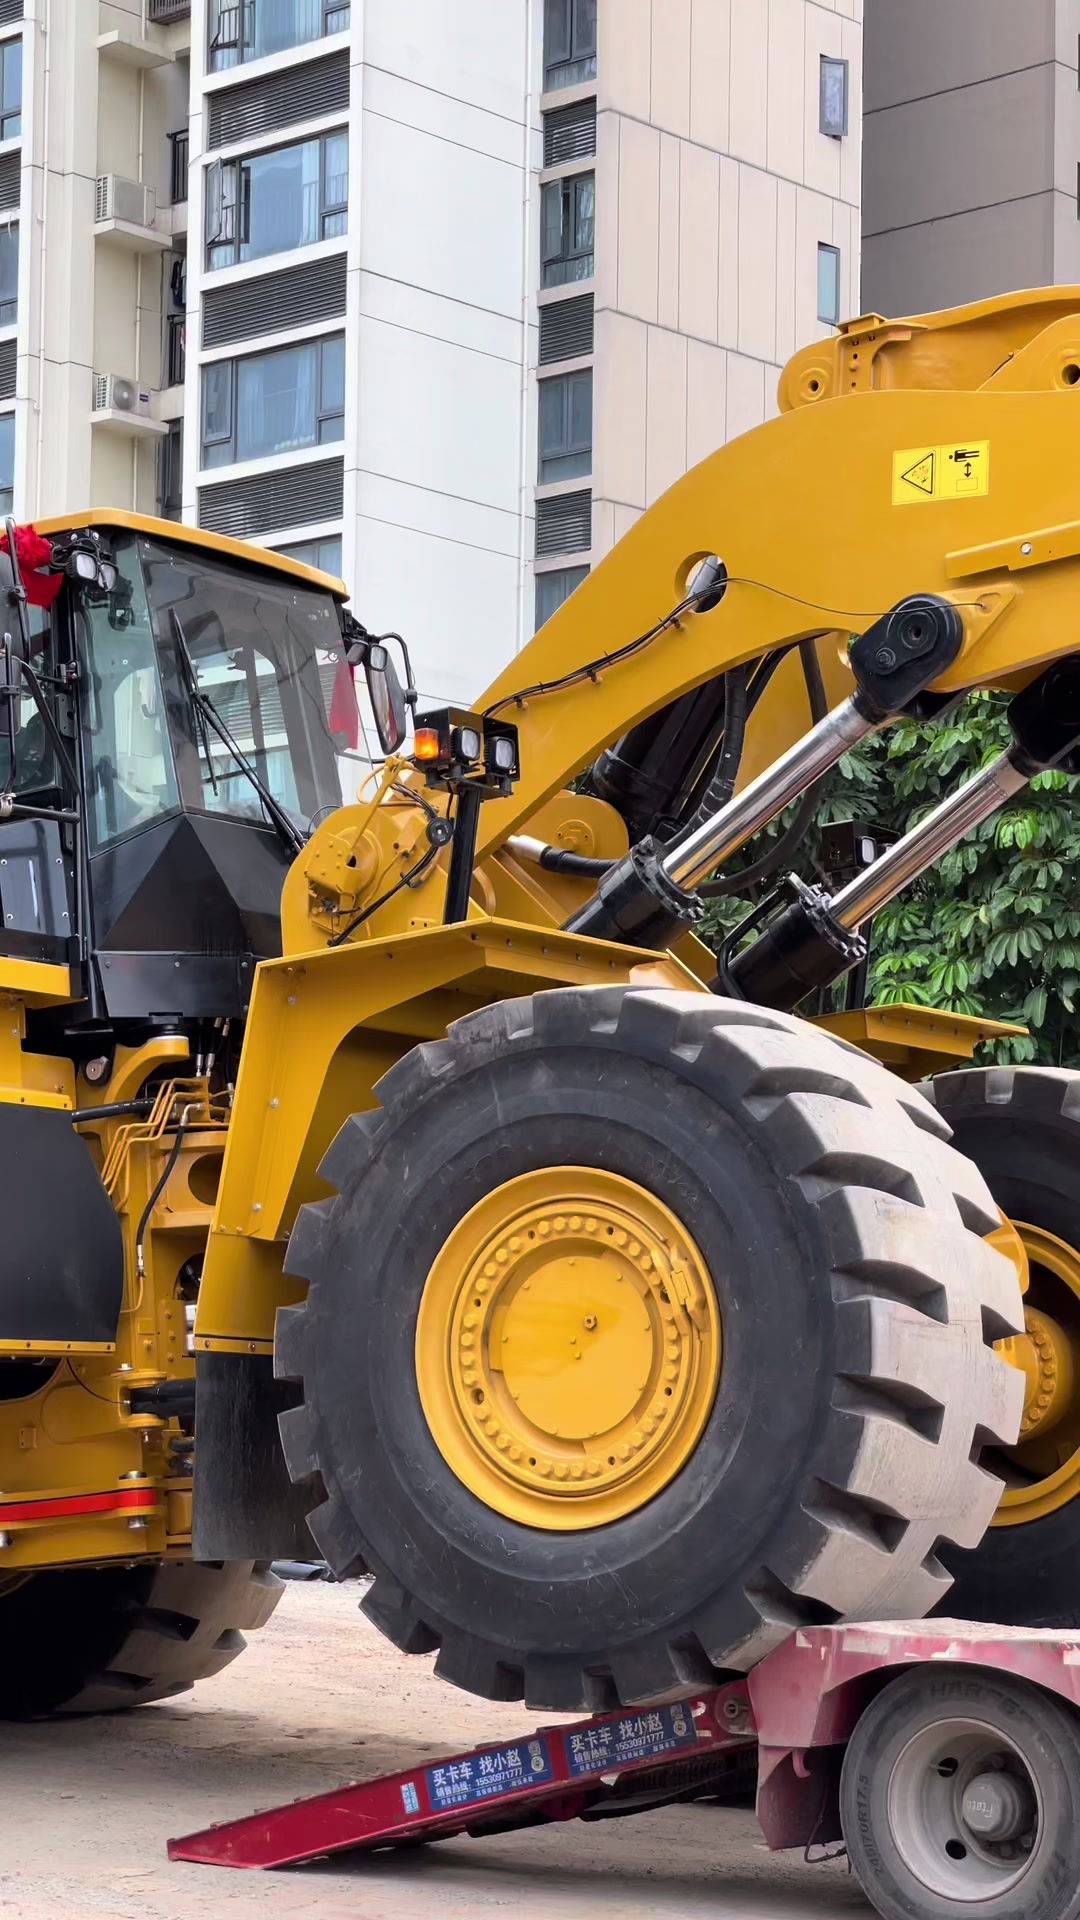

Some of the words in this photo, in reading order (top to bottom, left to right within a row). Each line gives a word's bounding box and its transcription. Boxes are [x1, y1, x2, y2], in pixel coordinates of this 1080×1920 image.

[570, 1726, 613, 1753] 买卡车
[618, 1712, 664, 1740] 找小赵
[615, 1731, 665, 1752] 15530971777
[432, 1761, 474, 1787] 买卡车
[479, 1748, 522, 1775] 找小赵
[475, 1767, 523, 1787] 15530971777
